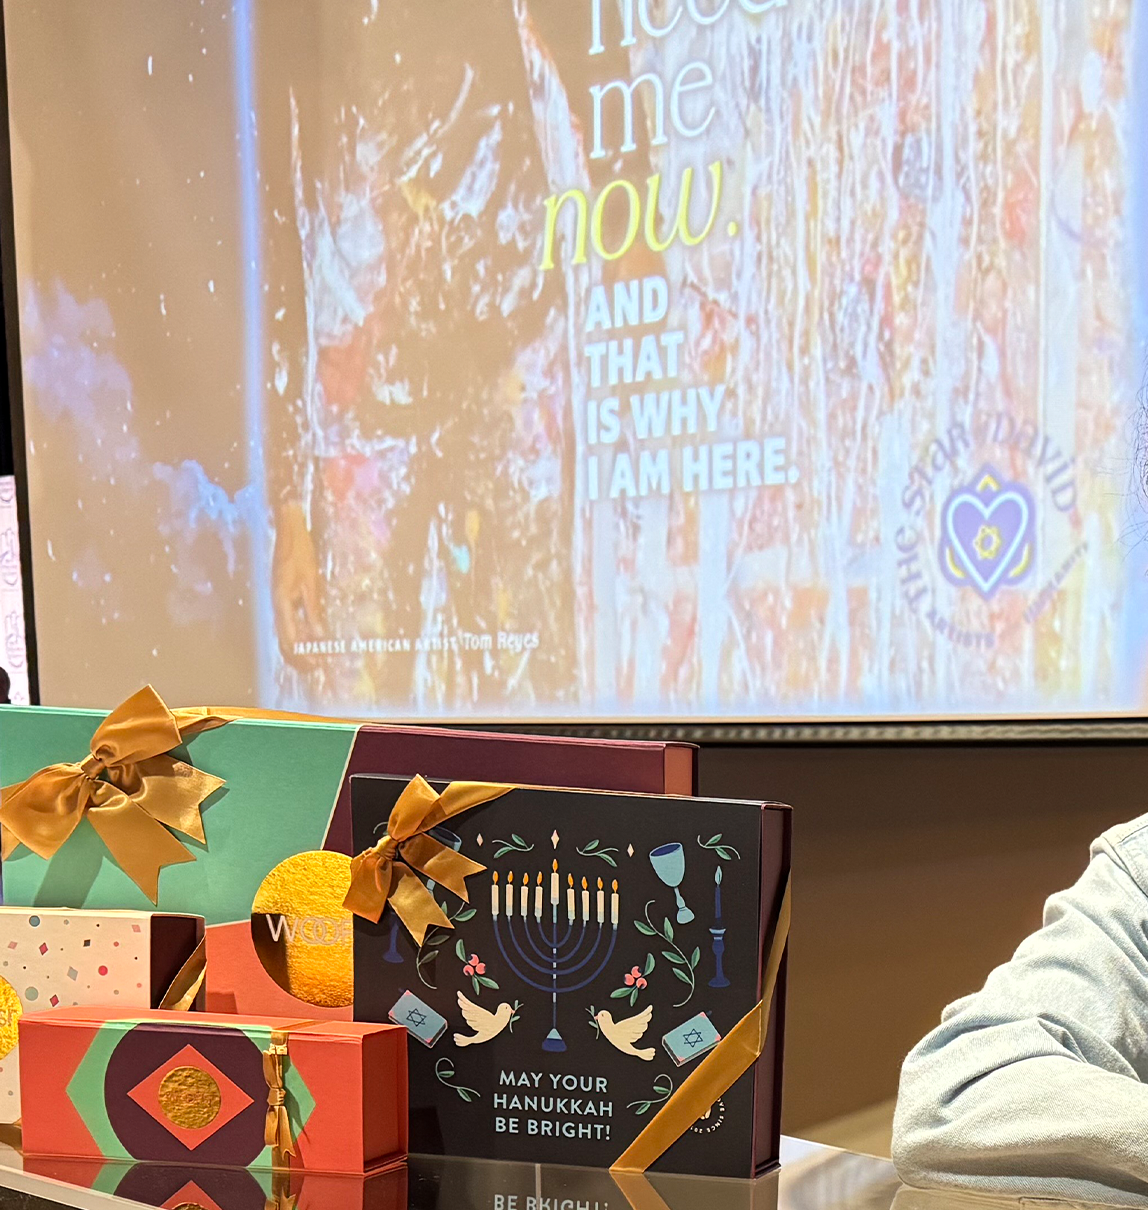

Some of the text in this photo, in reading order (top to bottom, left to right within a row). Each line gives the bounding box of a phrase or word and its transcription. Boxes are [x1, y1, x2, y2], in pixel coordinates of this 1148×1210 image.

[588, 61, 715, 159] me
[538, 160, 738, 270] now.
[585, 275, 669, 333] AND
[584, 331, 685, 388] THAT
[587, 384, 727, 444] IS WHY
[587, 436, 800, 500] I AM HERE.
[293, 639, 346, 654] JAPANESE
[350, 637, 411, 652] AMERICAN
[463, 631, 493, 650] Tom
[497, 631, 540, 652] Reyes
[493, 1093, 614, 1118] HANUKKAH
[499, 1069, 609, 1093] MAY YOUR
[495, 1116, 612, 1141] BE BRIGHT!
